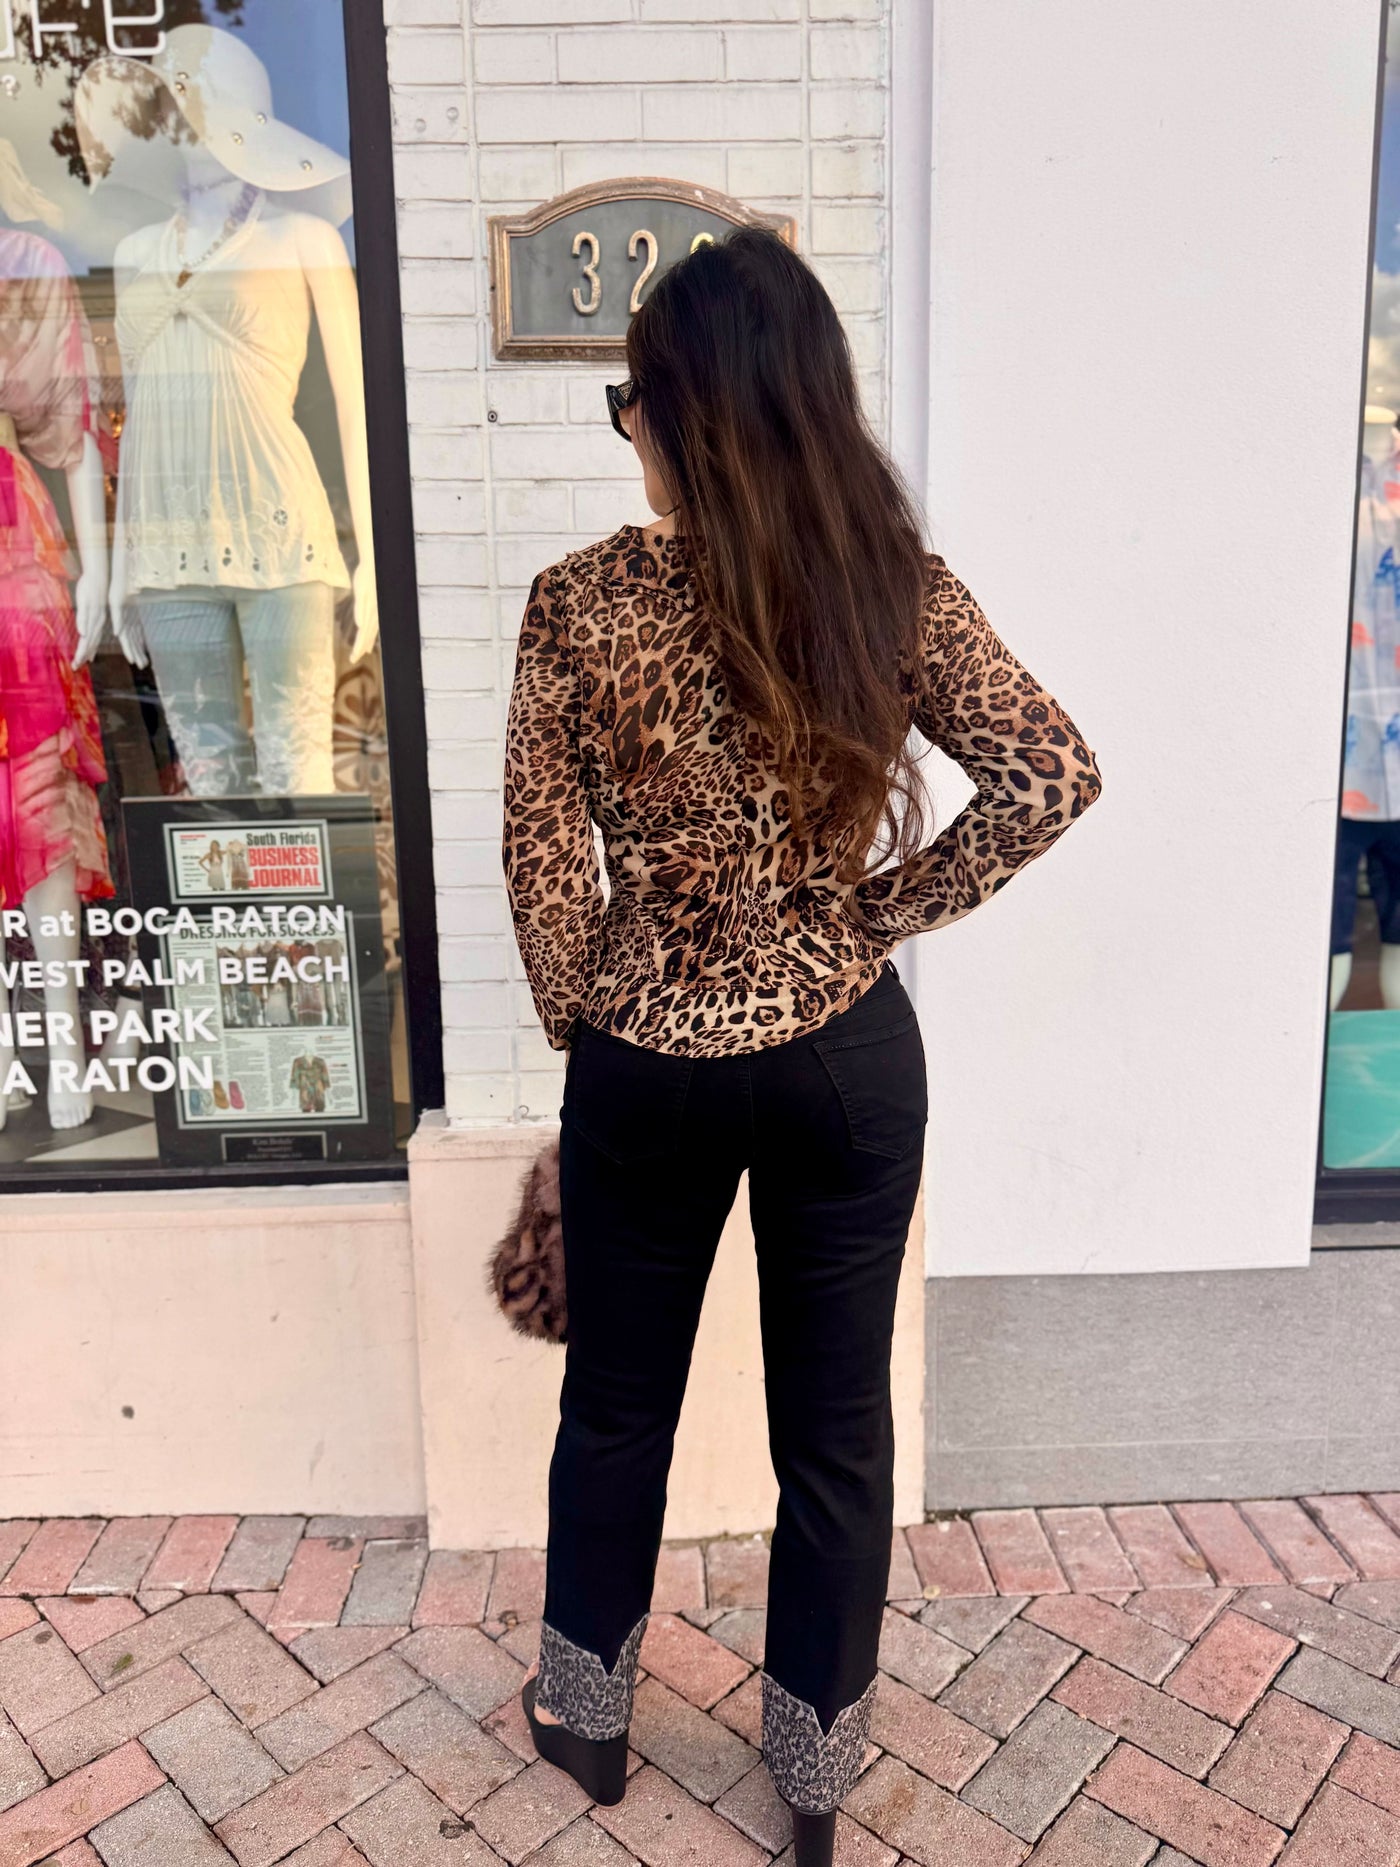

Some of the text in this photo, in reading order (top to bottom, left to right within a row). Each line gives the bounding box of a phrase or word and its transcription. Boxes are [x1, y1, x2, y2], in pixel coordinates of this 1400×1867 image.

[571, 228, 715, 317] 32
[246, 832, 316, 846] South Florida
[247, 846, 319, 867] BUSINESS
[248, 867, 321, 888] JOURNAL
[0, 904, 345, 938] R at BOCA RATON
[280, 923, 336, 938] SUCES
[102, 958, 206, 987] PALM
[219, 955, 349, 985] BEACH
[89, 1007, 219, 1046] PARK
[0, 1060, 39, 1095] A
[50, 1055, 214, 1095] RATON
